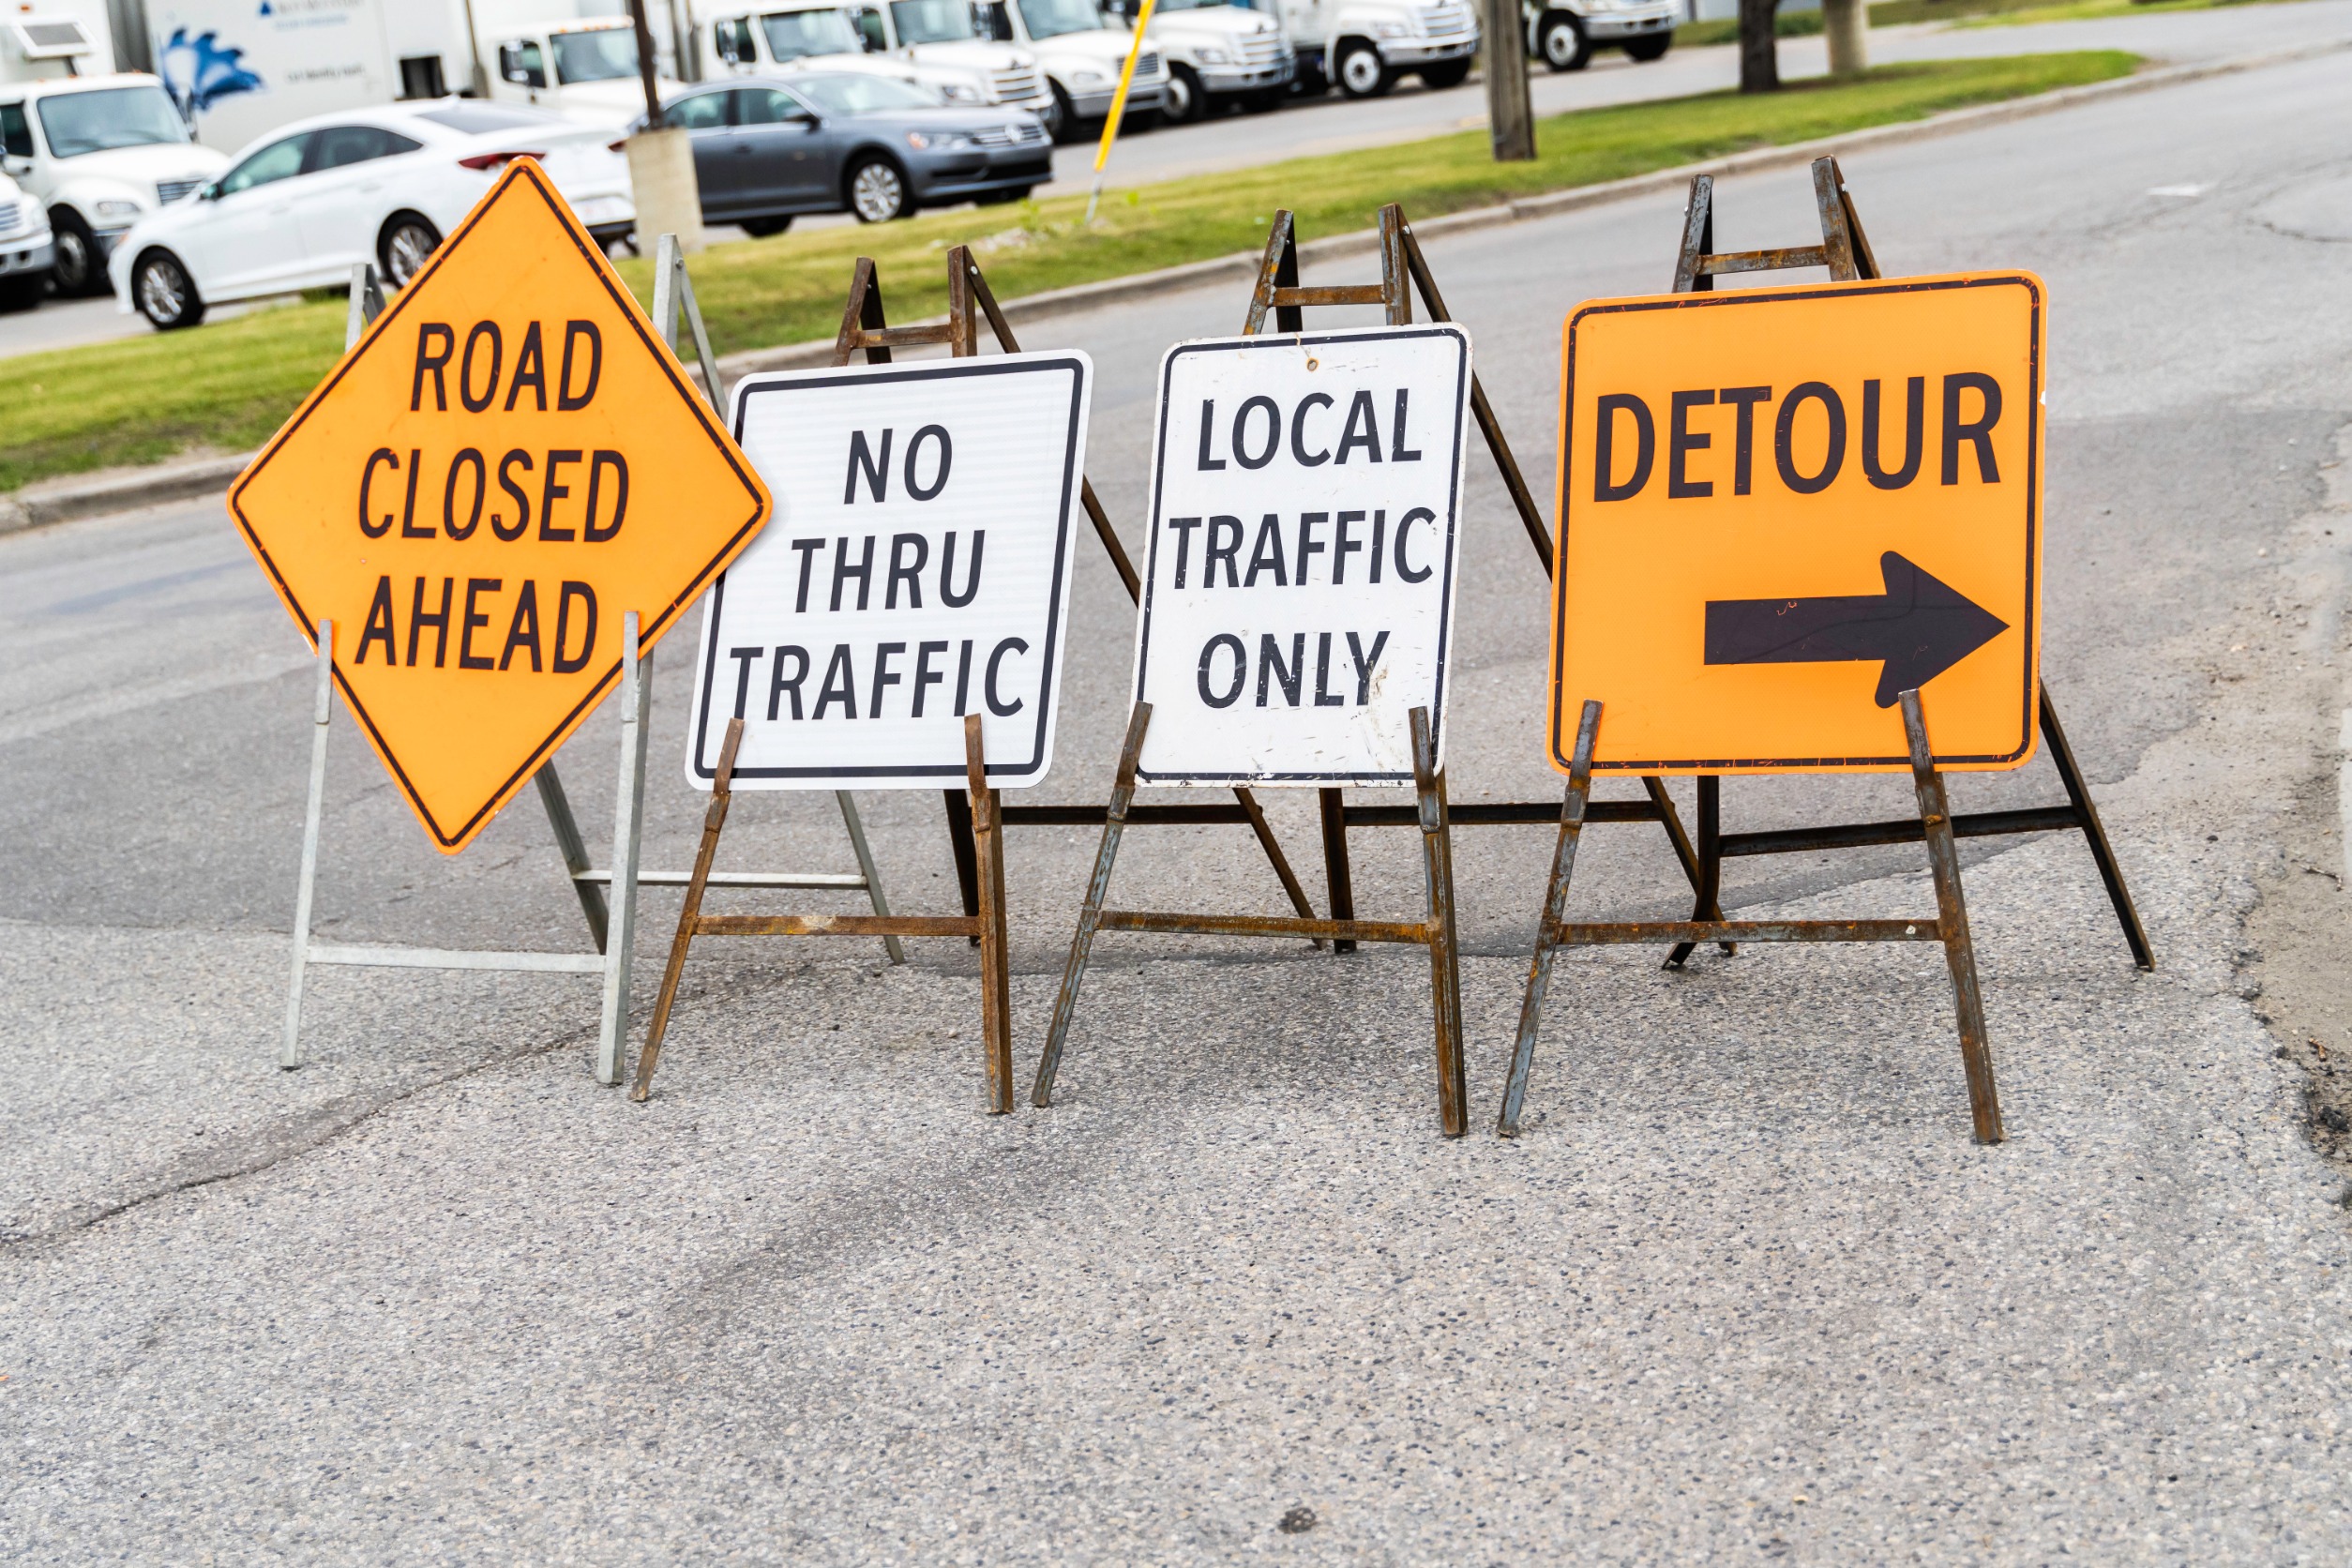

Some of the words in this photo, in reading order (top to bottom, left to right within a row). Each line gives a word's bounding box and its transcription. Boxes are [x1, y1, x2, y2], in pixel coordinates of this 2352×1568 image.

[410, 320, 602, 413] ROAD
[844, 424, 953, 505] NO
[1198, 388, 1422, 471] LOCAL
[1594, 371, 2002, 503] DETOUR
[358, 447, 629, 543] CLOSED
[792, 530, 986, 613] THRU
[1169, 506, 1437, 590] TRAFFIC
[354, 576, 598, 674] AHEAD
[730, 637, 1030, 720] TRAFFIC
[1197, 631, 1391, 709] ONLY
